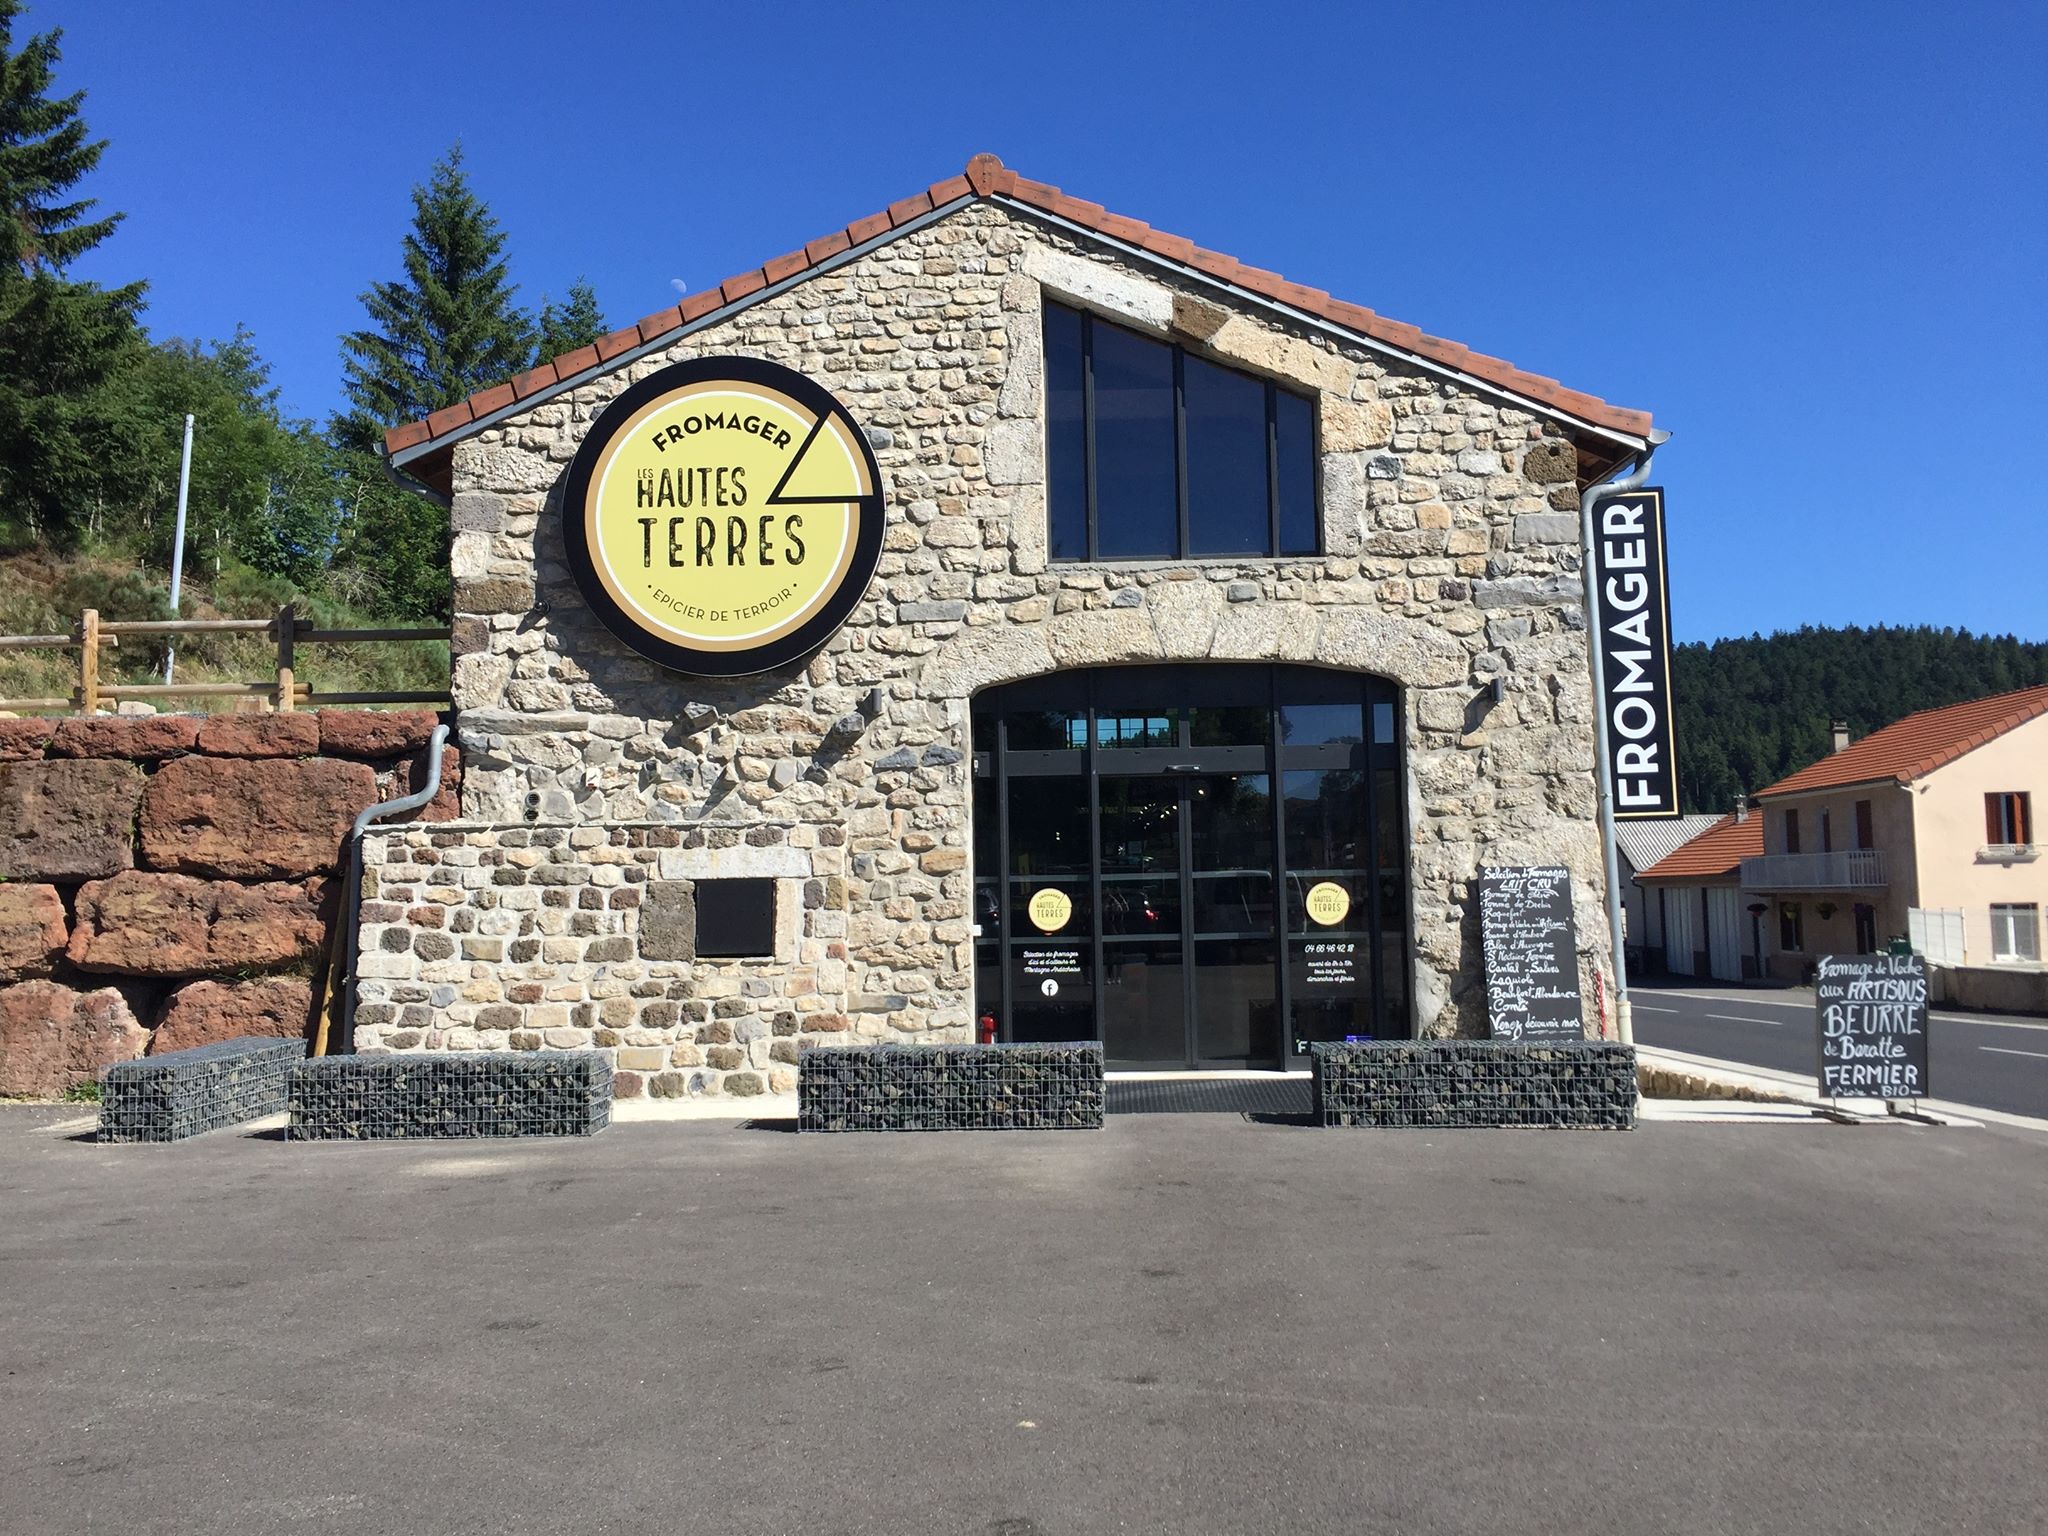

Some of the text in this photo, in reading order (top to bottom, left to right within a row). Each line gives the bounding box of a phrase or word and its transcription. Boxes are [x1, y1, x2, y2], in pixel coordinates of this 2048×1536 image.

[651, 412, 792, 452] FROMAGER
[637, 468, 654, 479] LES
[637, 466, 748, 508] HAUTES
[637, 514, 806, 568] TERRES
[652, 587, 793, 621] EPICIER DE TERROIR
[1602, 503, 1661, 806] FROMAGER
[1527, 880, 1551, 889] CRU
[1037, 909, 1063, 918] TERRES
[1314, 903, 1341, 912] TERRES
[1305, 944, 1315, 953] 04
[1326, 944, 1336, 953] 46
[1337, 944, 1345, 953] 42
[1488, 961, 1520, 973] Cantal
[1818, 955, 1924, 981] Fromage de Vache
[1489, 973, 1534, 992] Laguiole
[1820, 985, 1844, 997] aux
[1493, 999, 1528, 1012] Comté
[1489, 1013, 1522, 1040] Venez
[1823, 1004, 1921, 1037] BEURRE
[1824, 1036, 1907, 1060] de Baratte
[1882, 1085, 1909, 1097] BIO
